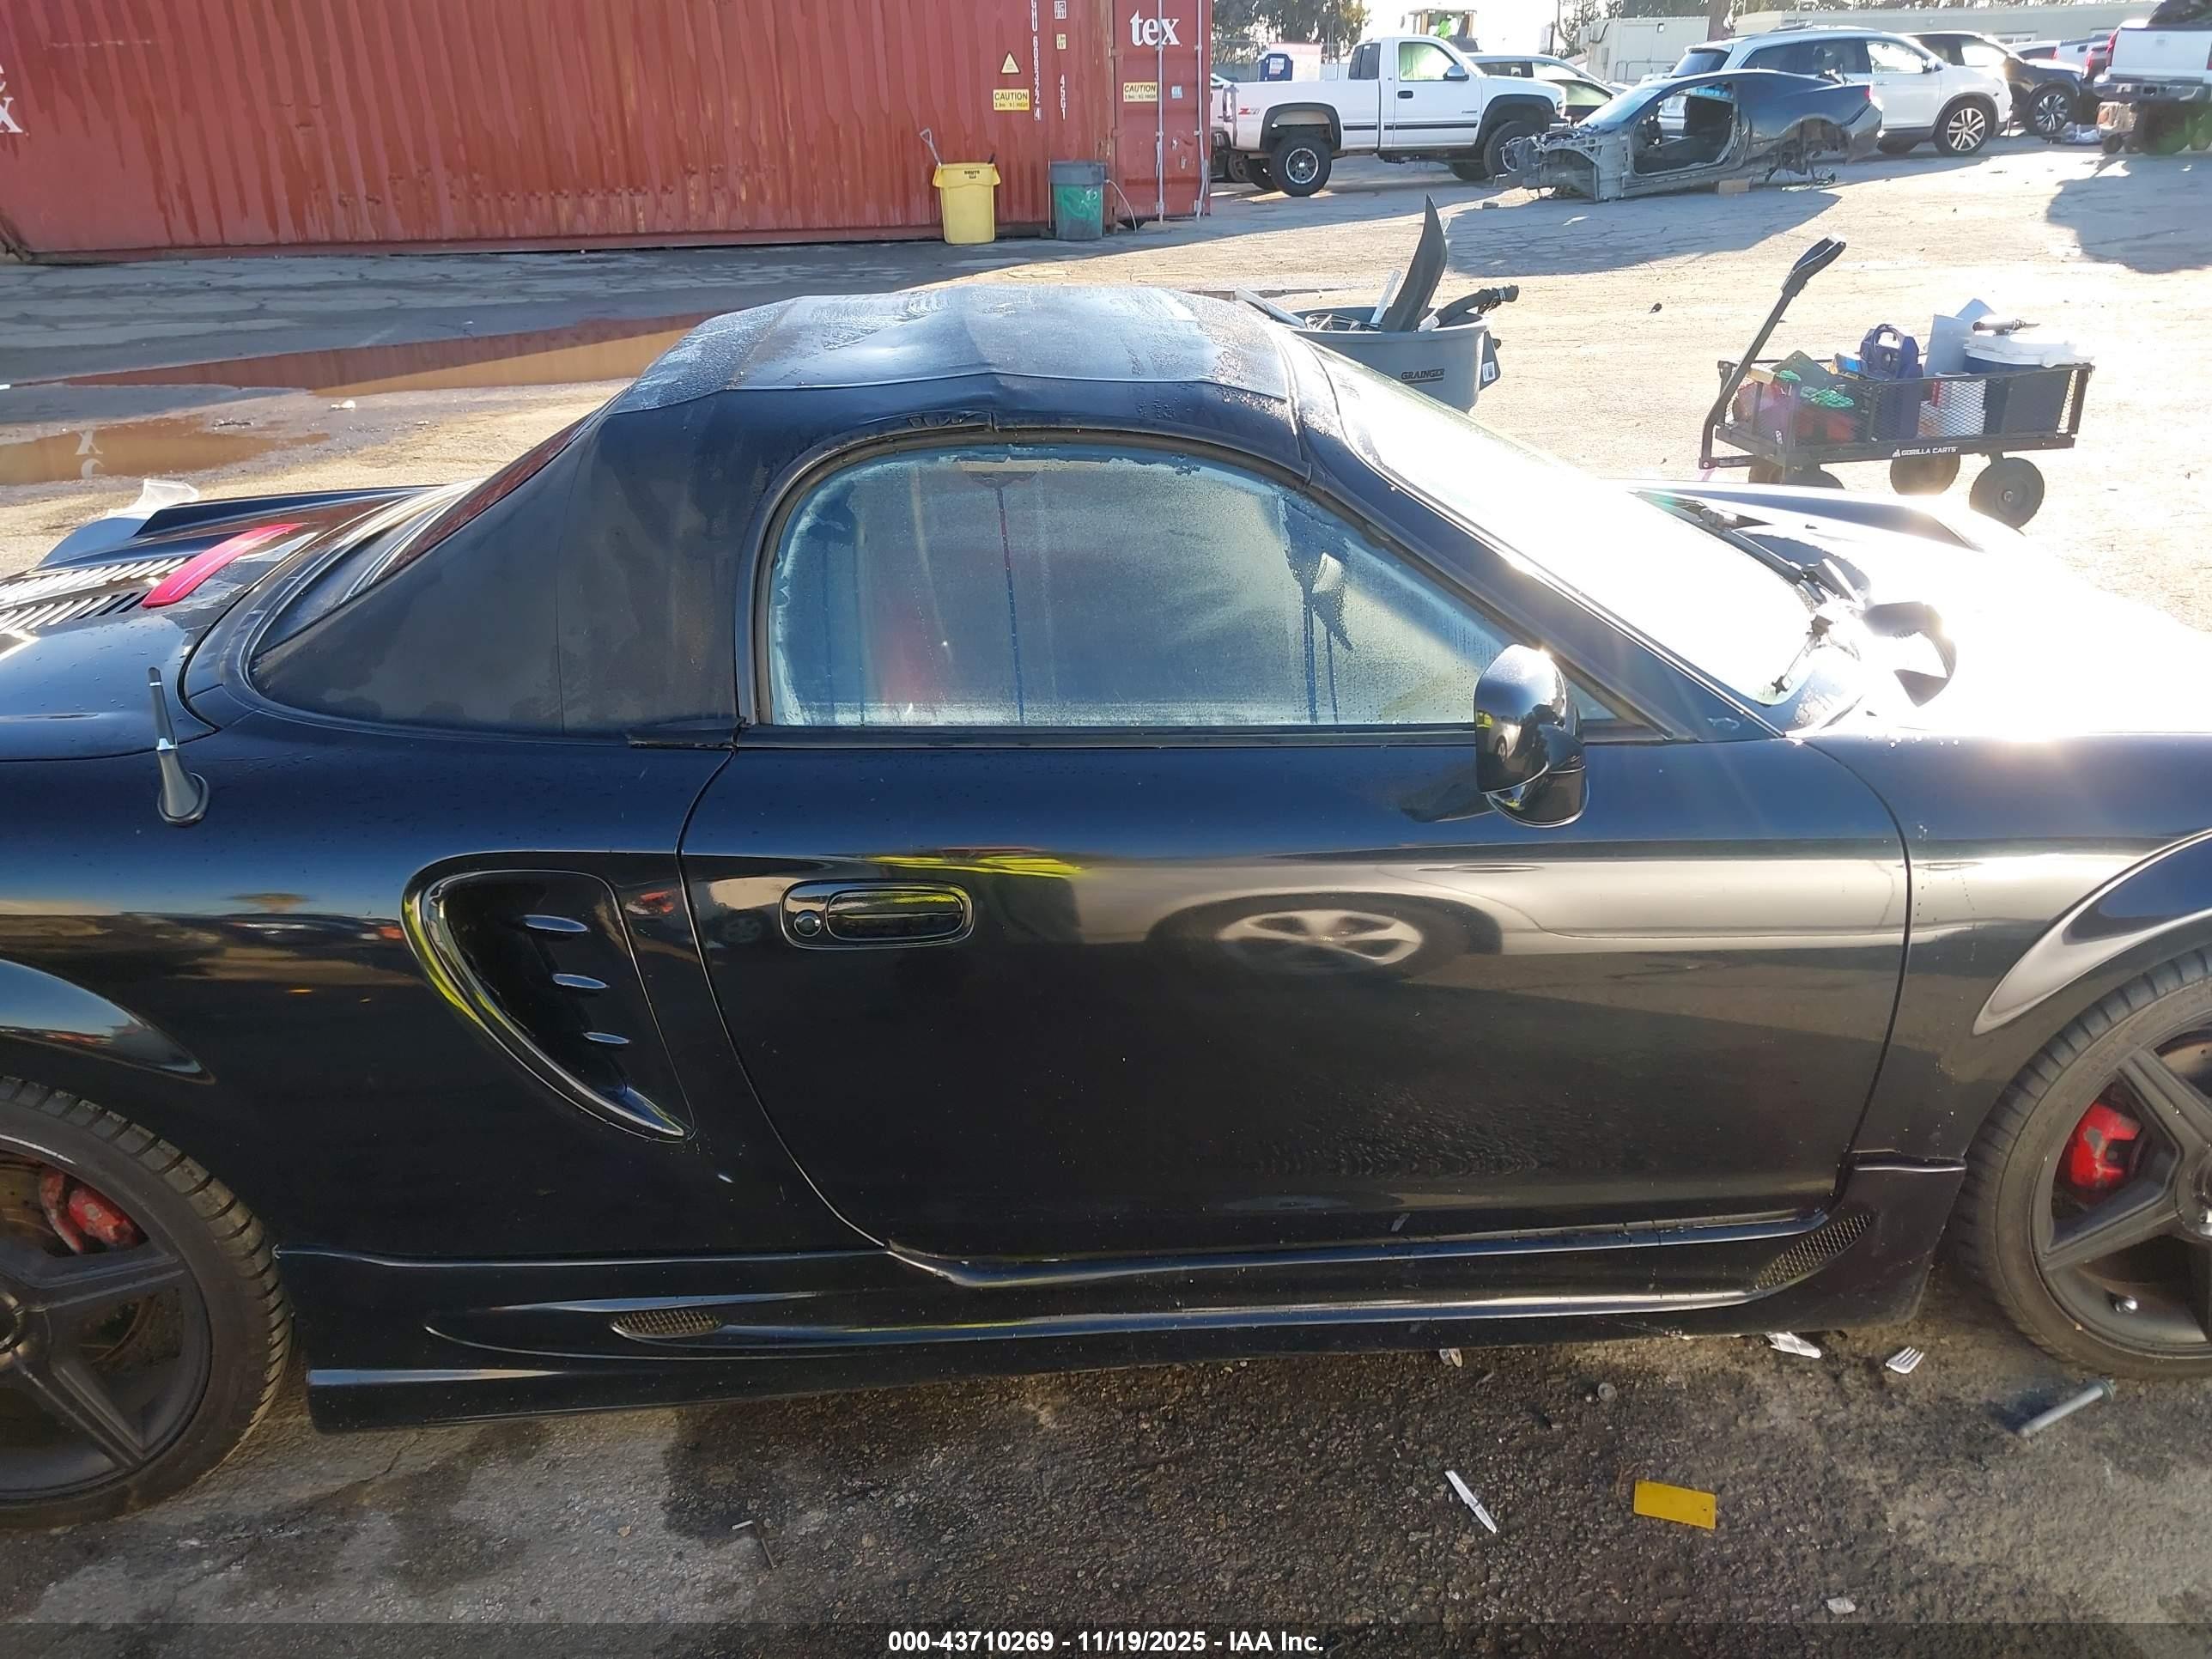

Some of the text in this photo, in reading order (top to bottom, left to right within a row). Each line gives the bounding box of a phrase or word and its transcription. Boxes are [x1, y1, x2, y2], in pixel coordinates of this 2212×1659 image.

[1129, 9, 1180, 46] tex
[1124, 84, 1157, 93] CAUTION
[994, 91, 1028, 100] CAUTION
